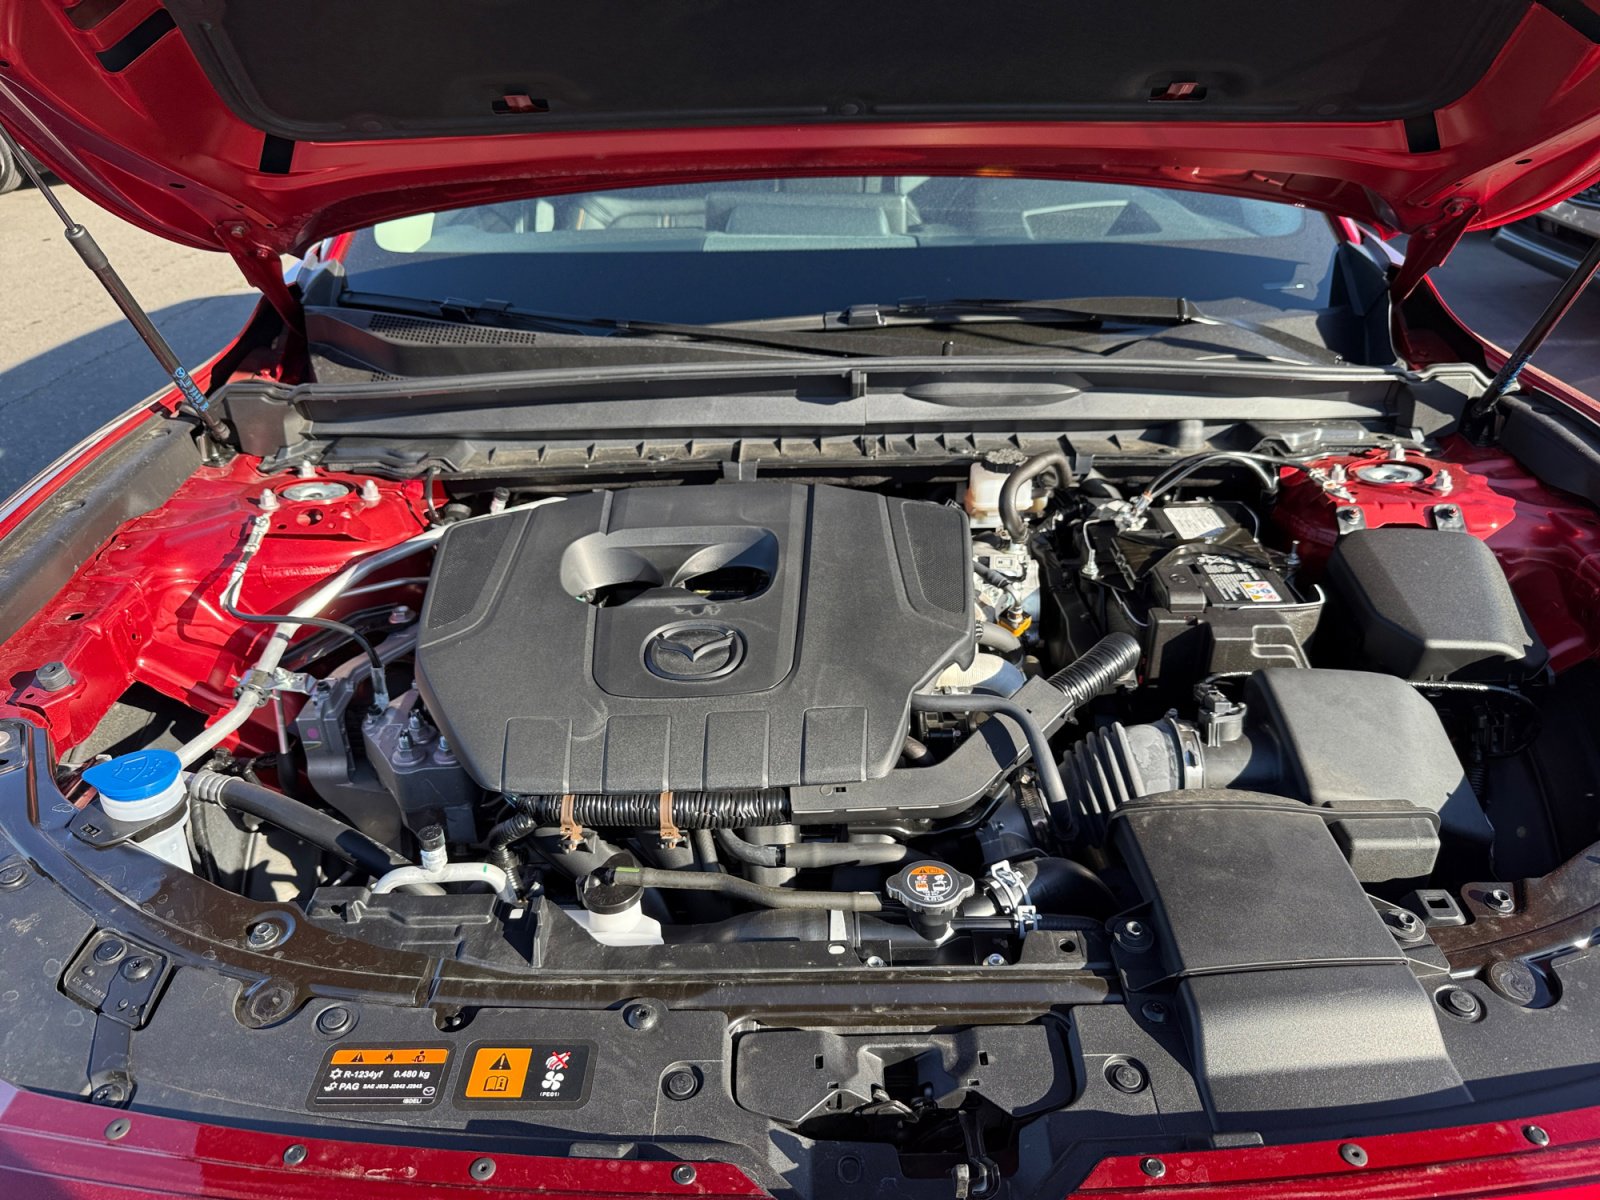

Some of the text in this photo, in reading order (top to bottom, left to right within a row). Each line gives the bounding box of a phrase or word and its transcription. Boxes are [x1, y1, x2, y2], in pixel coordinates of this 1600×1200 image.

[343, 1070, 431, 1080] R-1234yf 0.480 kg
[338, 1082, 360, 1091] PAG
